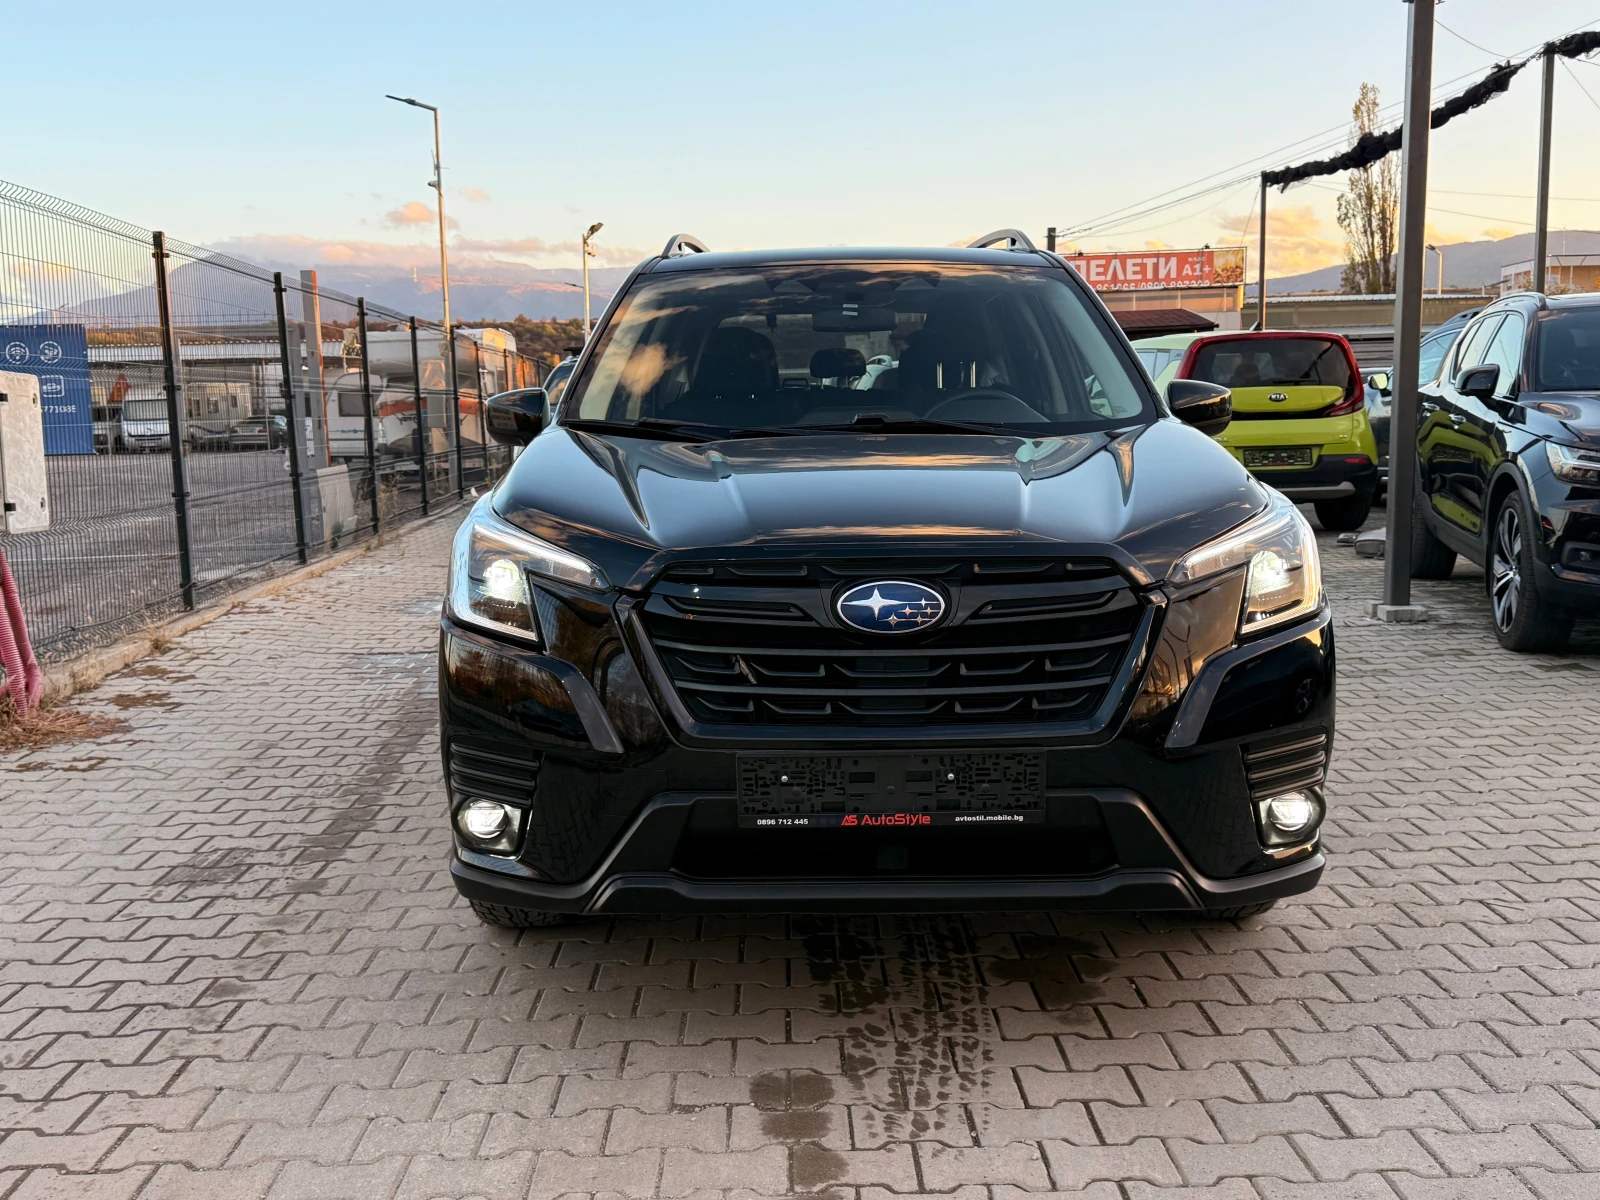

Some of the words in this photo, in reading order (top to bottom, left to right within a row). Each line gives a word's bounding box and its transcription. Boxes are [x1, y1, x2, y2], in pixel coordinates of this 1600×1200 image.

[1073, 256, 1178, 282] ПЕЛЕТИ
[861, 813, 931, 826] AutoStyle
[955, 814, 1024, 822] avtostil.mobile.bg
